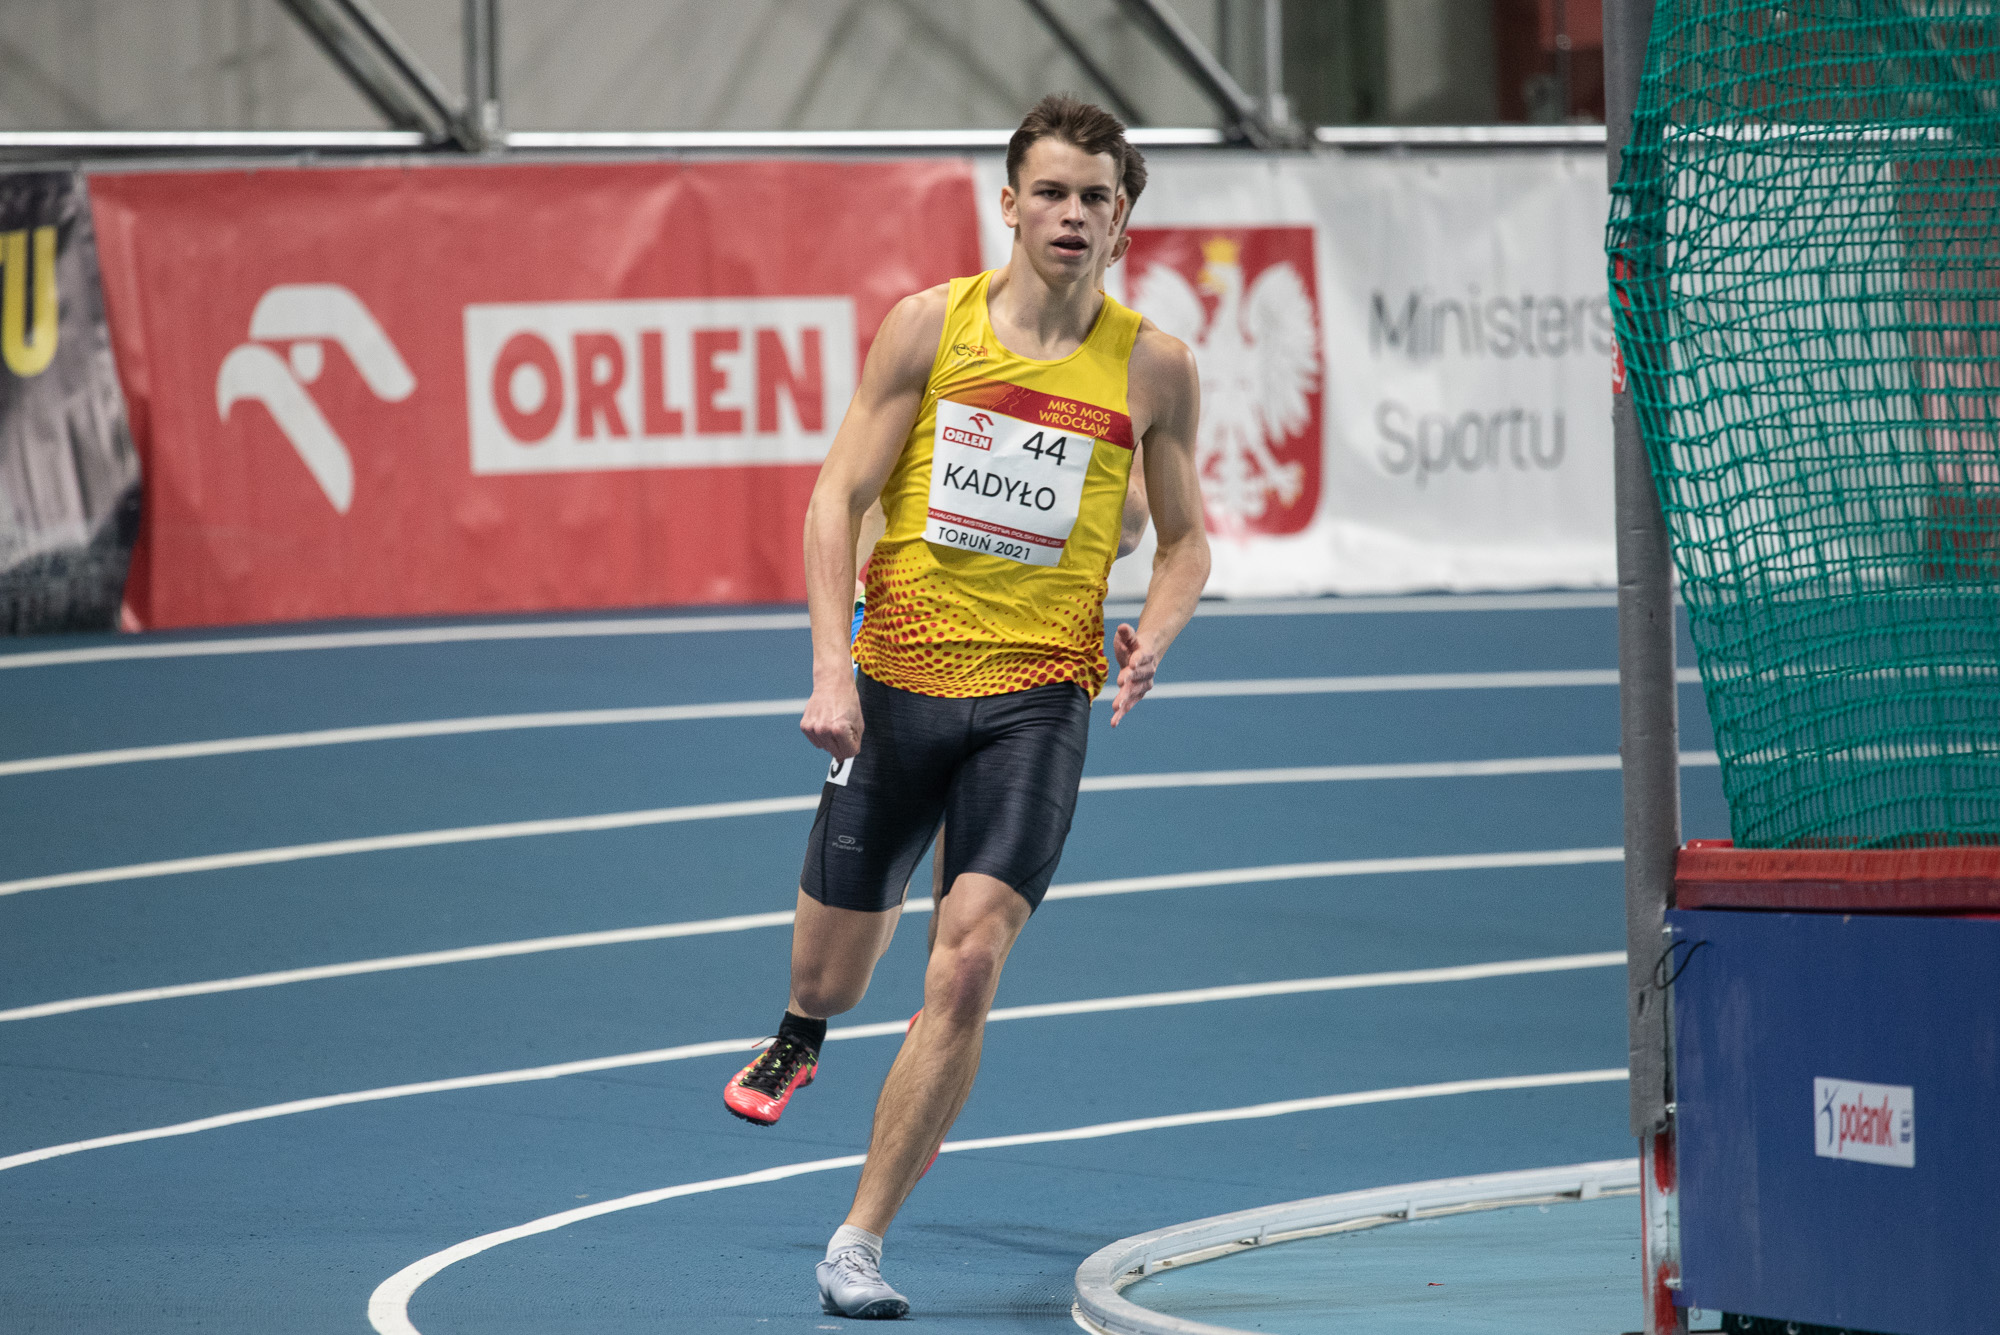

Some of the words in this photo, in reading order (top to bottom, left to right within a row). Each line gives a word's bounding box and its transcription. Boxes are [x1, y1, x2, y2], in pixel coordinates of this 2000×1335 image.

[490, 326, 825, 445] ORLEN
[1038, 409, 1110, 437] WROCŁAW
[1047, 399, 1078, 415] MKS
[1080, 408, 1111, 425] MOS
[944, 429, 991, 450] ORLEN
[1022, 431, 1067, 466] 44
[1375, 399, 1567, 489] Sportu
[943, 462, 1056, 511] KADYŁO
[938, 526, 992, 551] TORUŃ
[994, 541, 1031, 560] 2021
[1838, 1090, 1893, 1154] polanik
